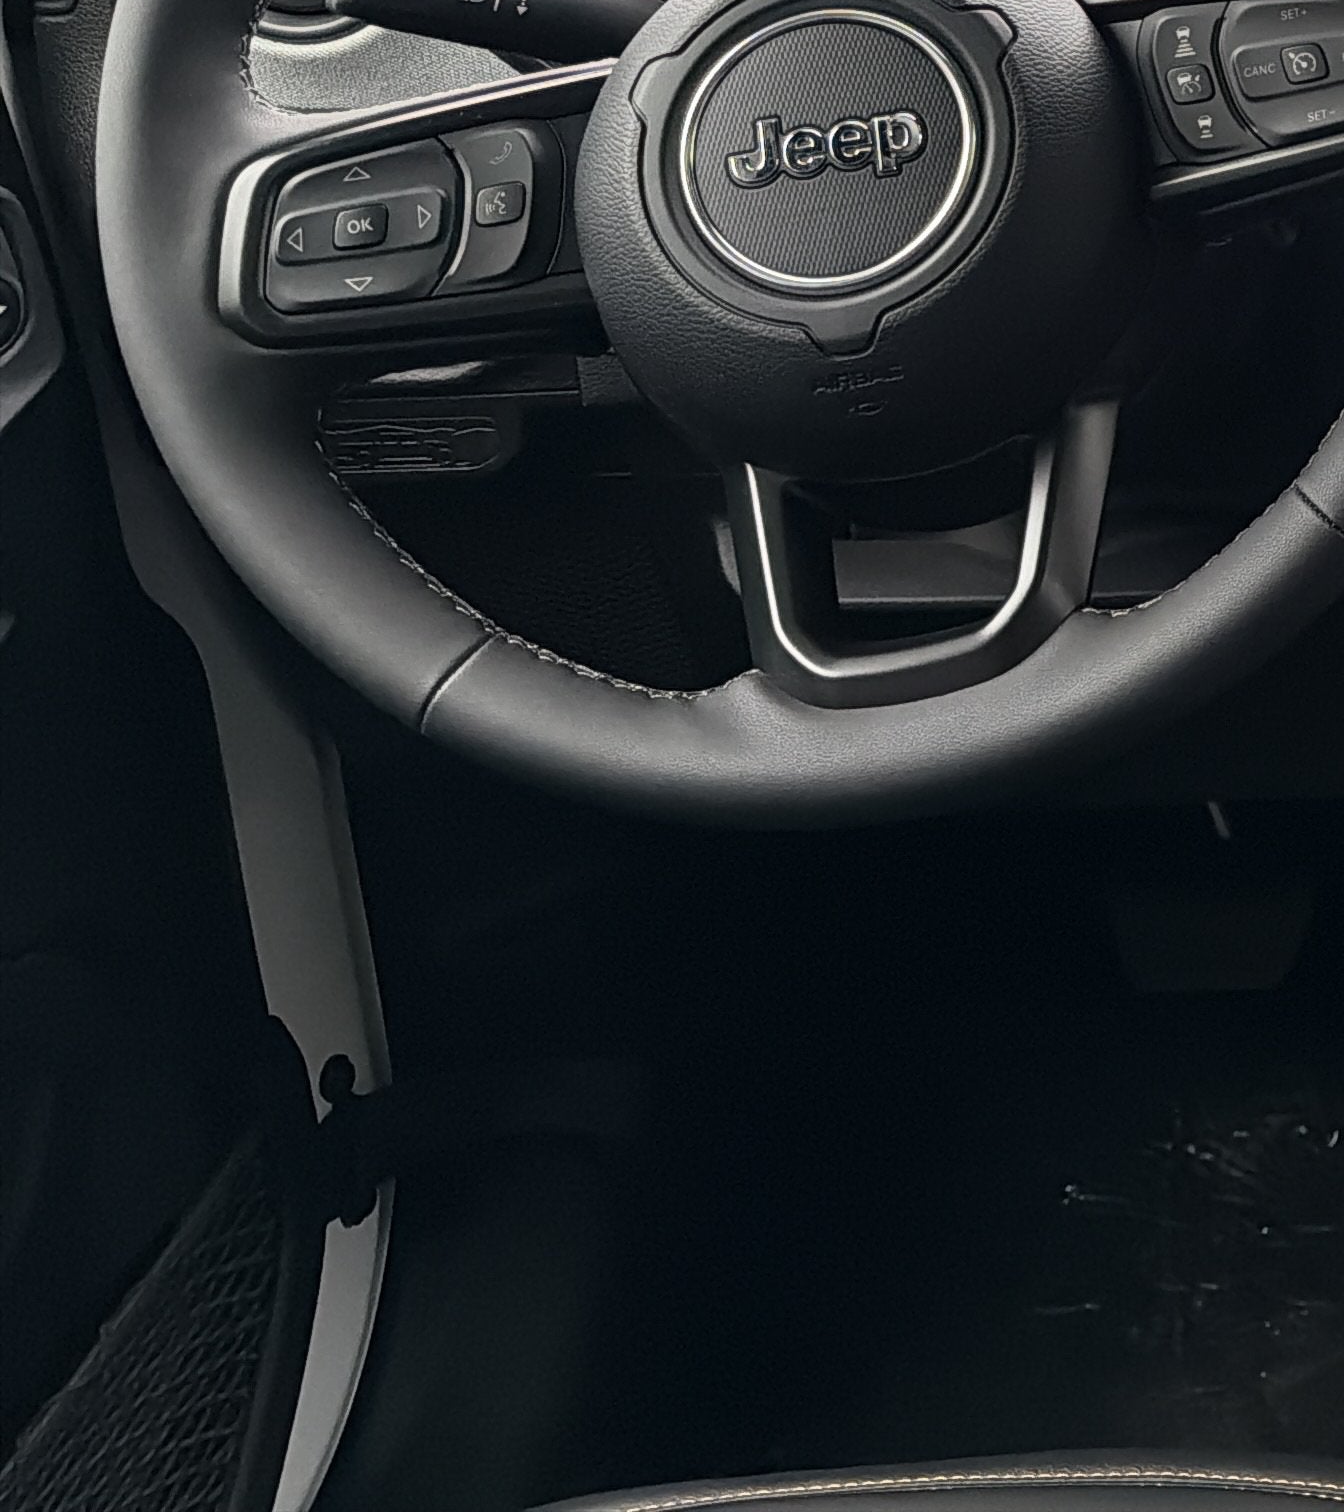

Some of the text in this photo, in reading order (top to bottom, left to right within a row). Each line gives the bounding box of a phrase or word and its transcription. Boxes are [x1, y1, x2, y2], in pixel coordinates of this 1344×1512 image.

[1243, 63, 1277, 78] CANC
[727, 112, 926, 187] Jeep
[346, 215, 375, 236] OK
